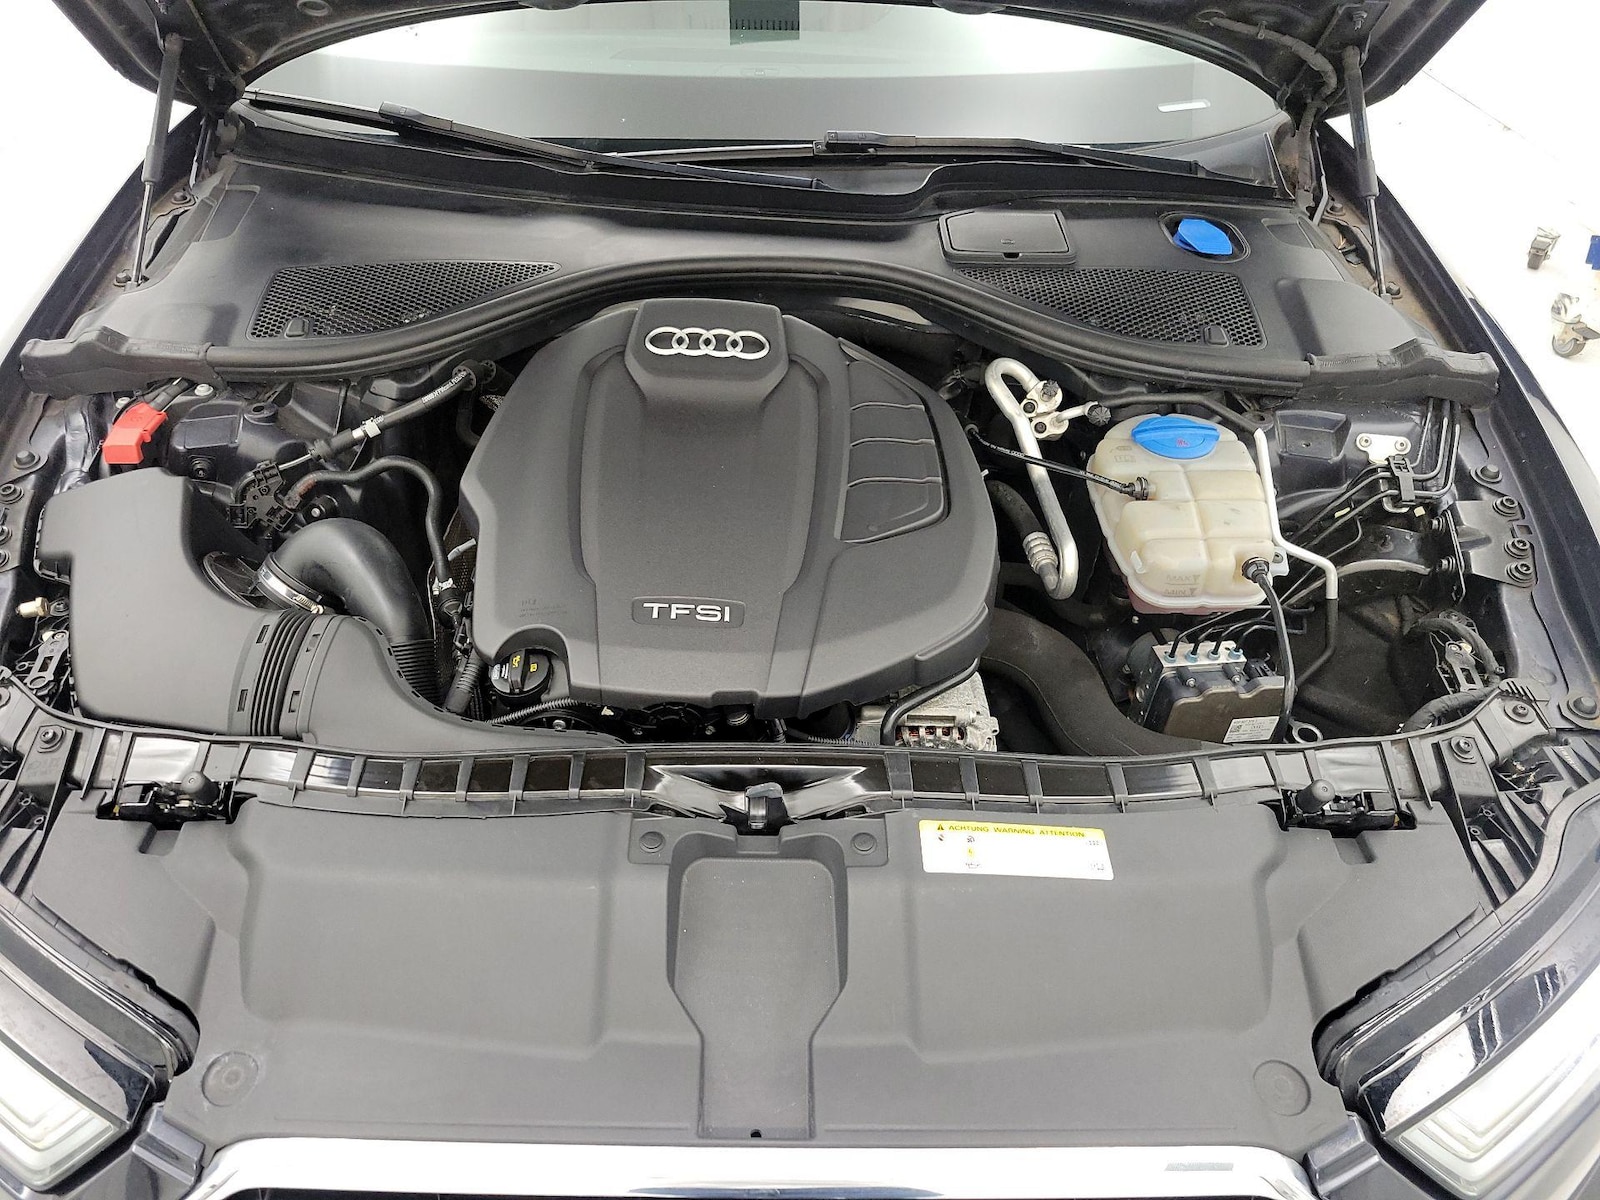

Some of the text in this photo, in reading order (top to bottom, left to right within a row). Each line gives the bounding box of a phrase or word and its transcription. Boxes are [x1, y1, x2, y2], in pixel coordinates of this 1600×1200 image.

[1166, 574, 1192, 582] MAX
[643, 603, 730, 623] TFSI
[1039, 829, 1085, 837] ATTENTION
